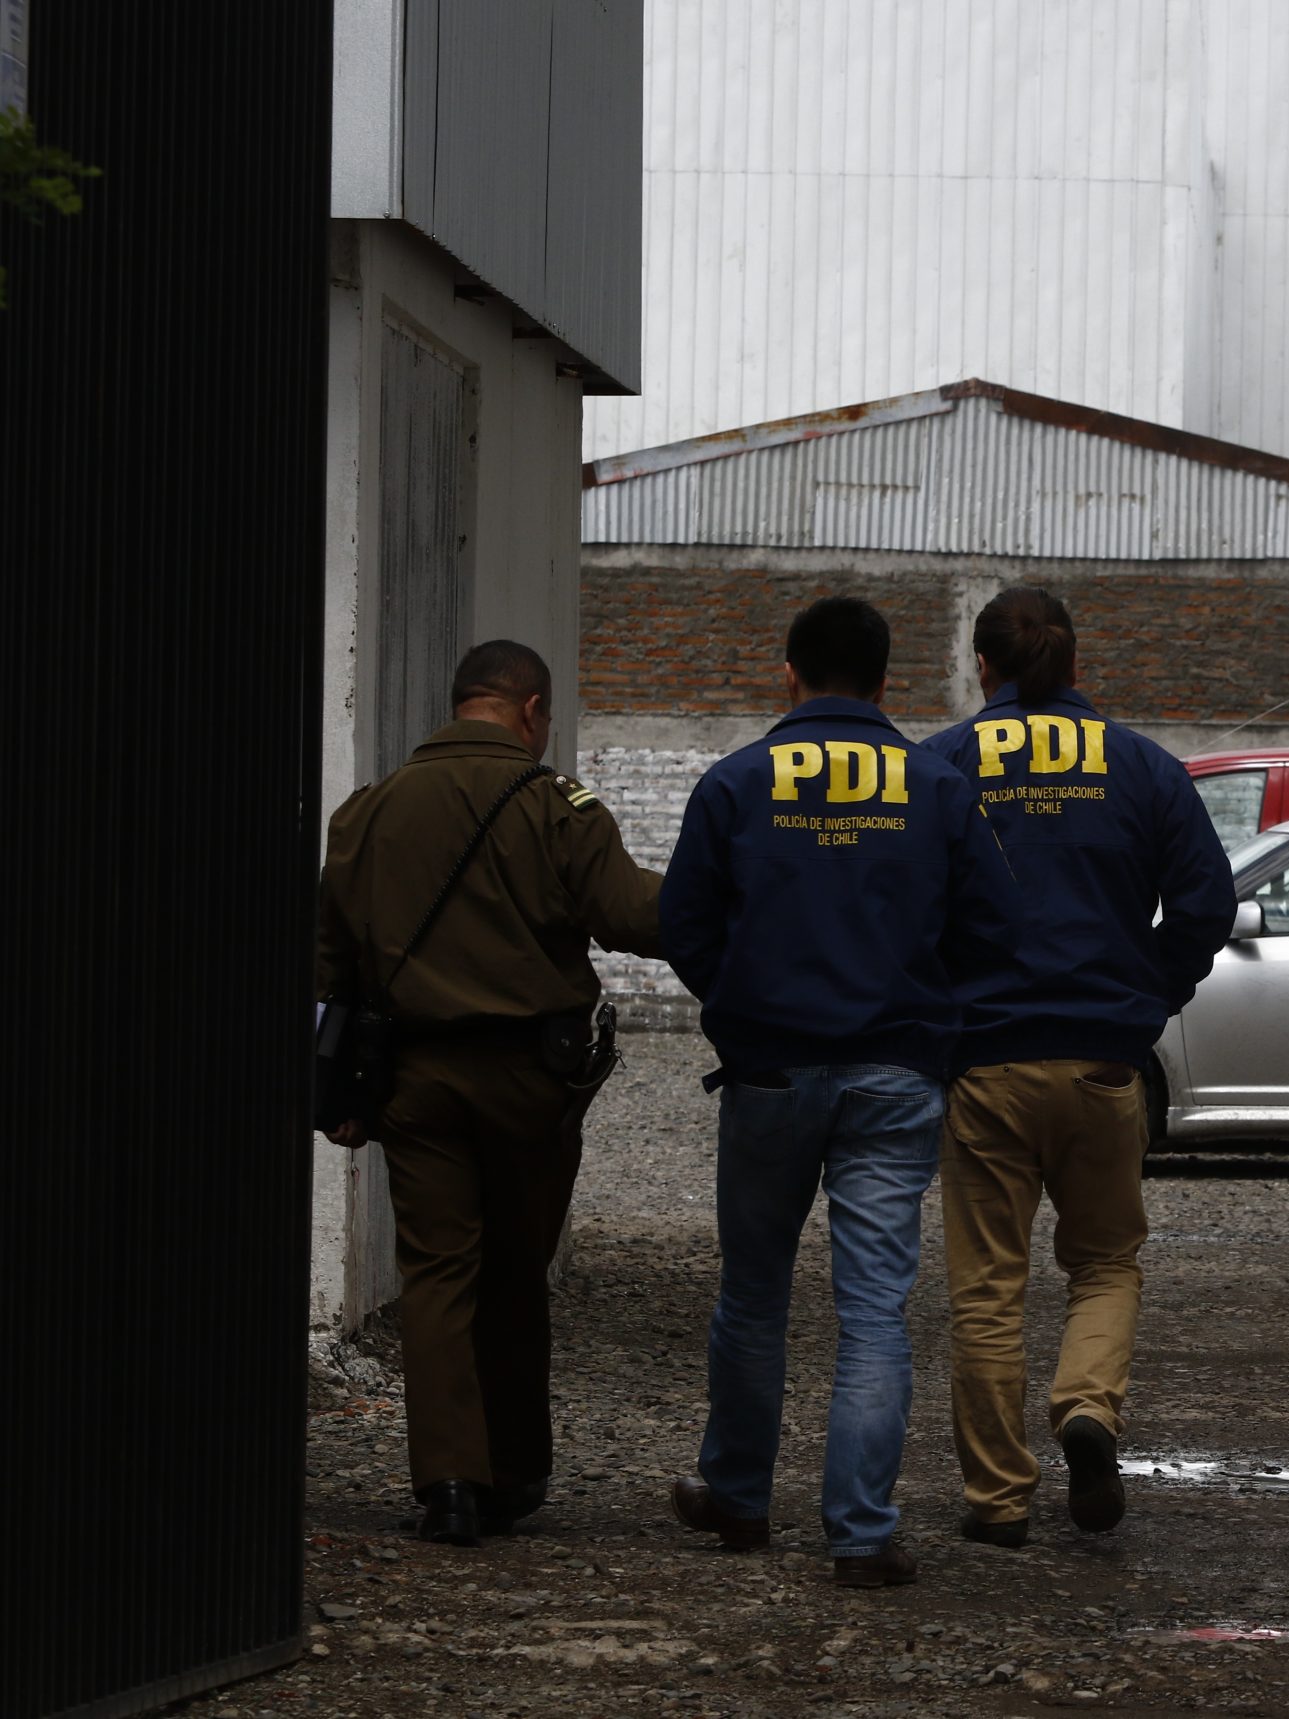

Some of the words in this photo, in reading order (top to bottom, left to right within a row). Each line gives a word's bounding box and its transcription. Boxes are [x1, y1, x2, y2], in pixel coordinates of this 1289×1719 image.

[974, 714, 1108, 777] PDI
[769, 741, 909, 804] PDI
[982, 788, 1015, 803] POLICÍA
[1017, 787, 1028, 798] DE
[1029, 787, 1105, 800] INVESTIGACIONES
[1025, 802, 1035, 814] DE
[1037, 802, 1062, 814] CHILE
[773, 814, 808, 829] POLICÍA
[810, 817, 822, 829] DE
[824, 816, 905, 830] INVESTIGACIONES
[818, 833, 831, 845] DE
[833, 832, 858, 845] CHILE
